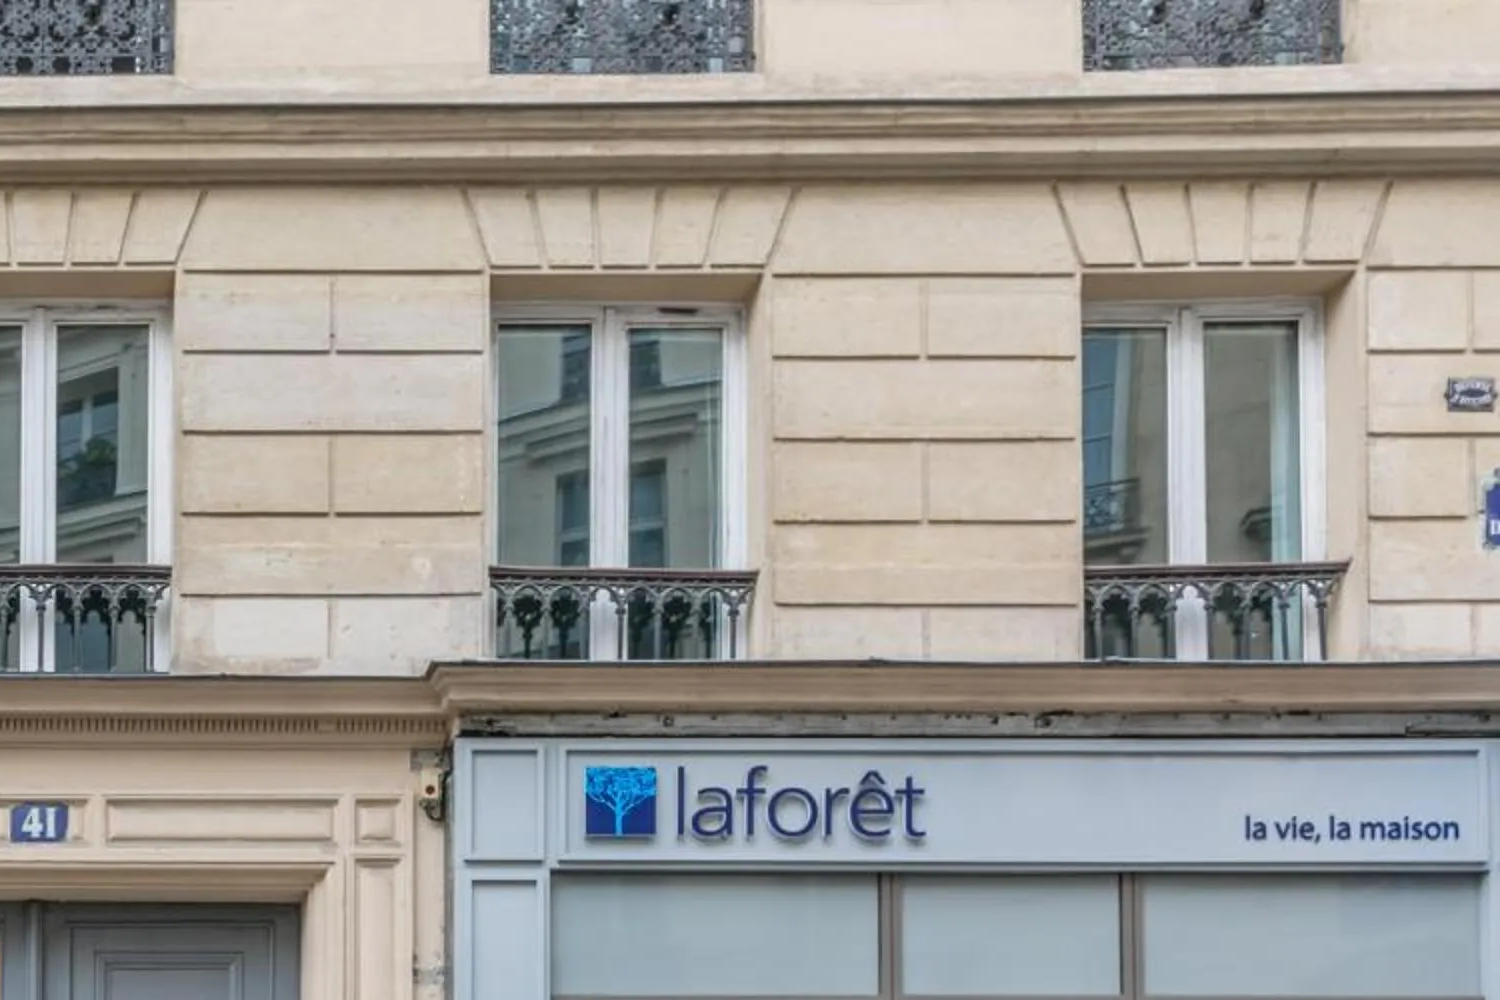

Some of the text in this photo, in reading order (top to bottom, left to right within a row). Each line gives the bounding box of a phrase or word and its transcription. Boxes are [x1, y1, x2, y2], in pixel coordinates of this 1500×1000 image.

[677, 765, 927, 837] laforêt
[21, 806, 57, 838] 41
[1245, 815, 1460, 844] la vie, la maison
